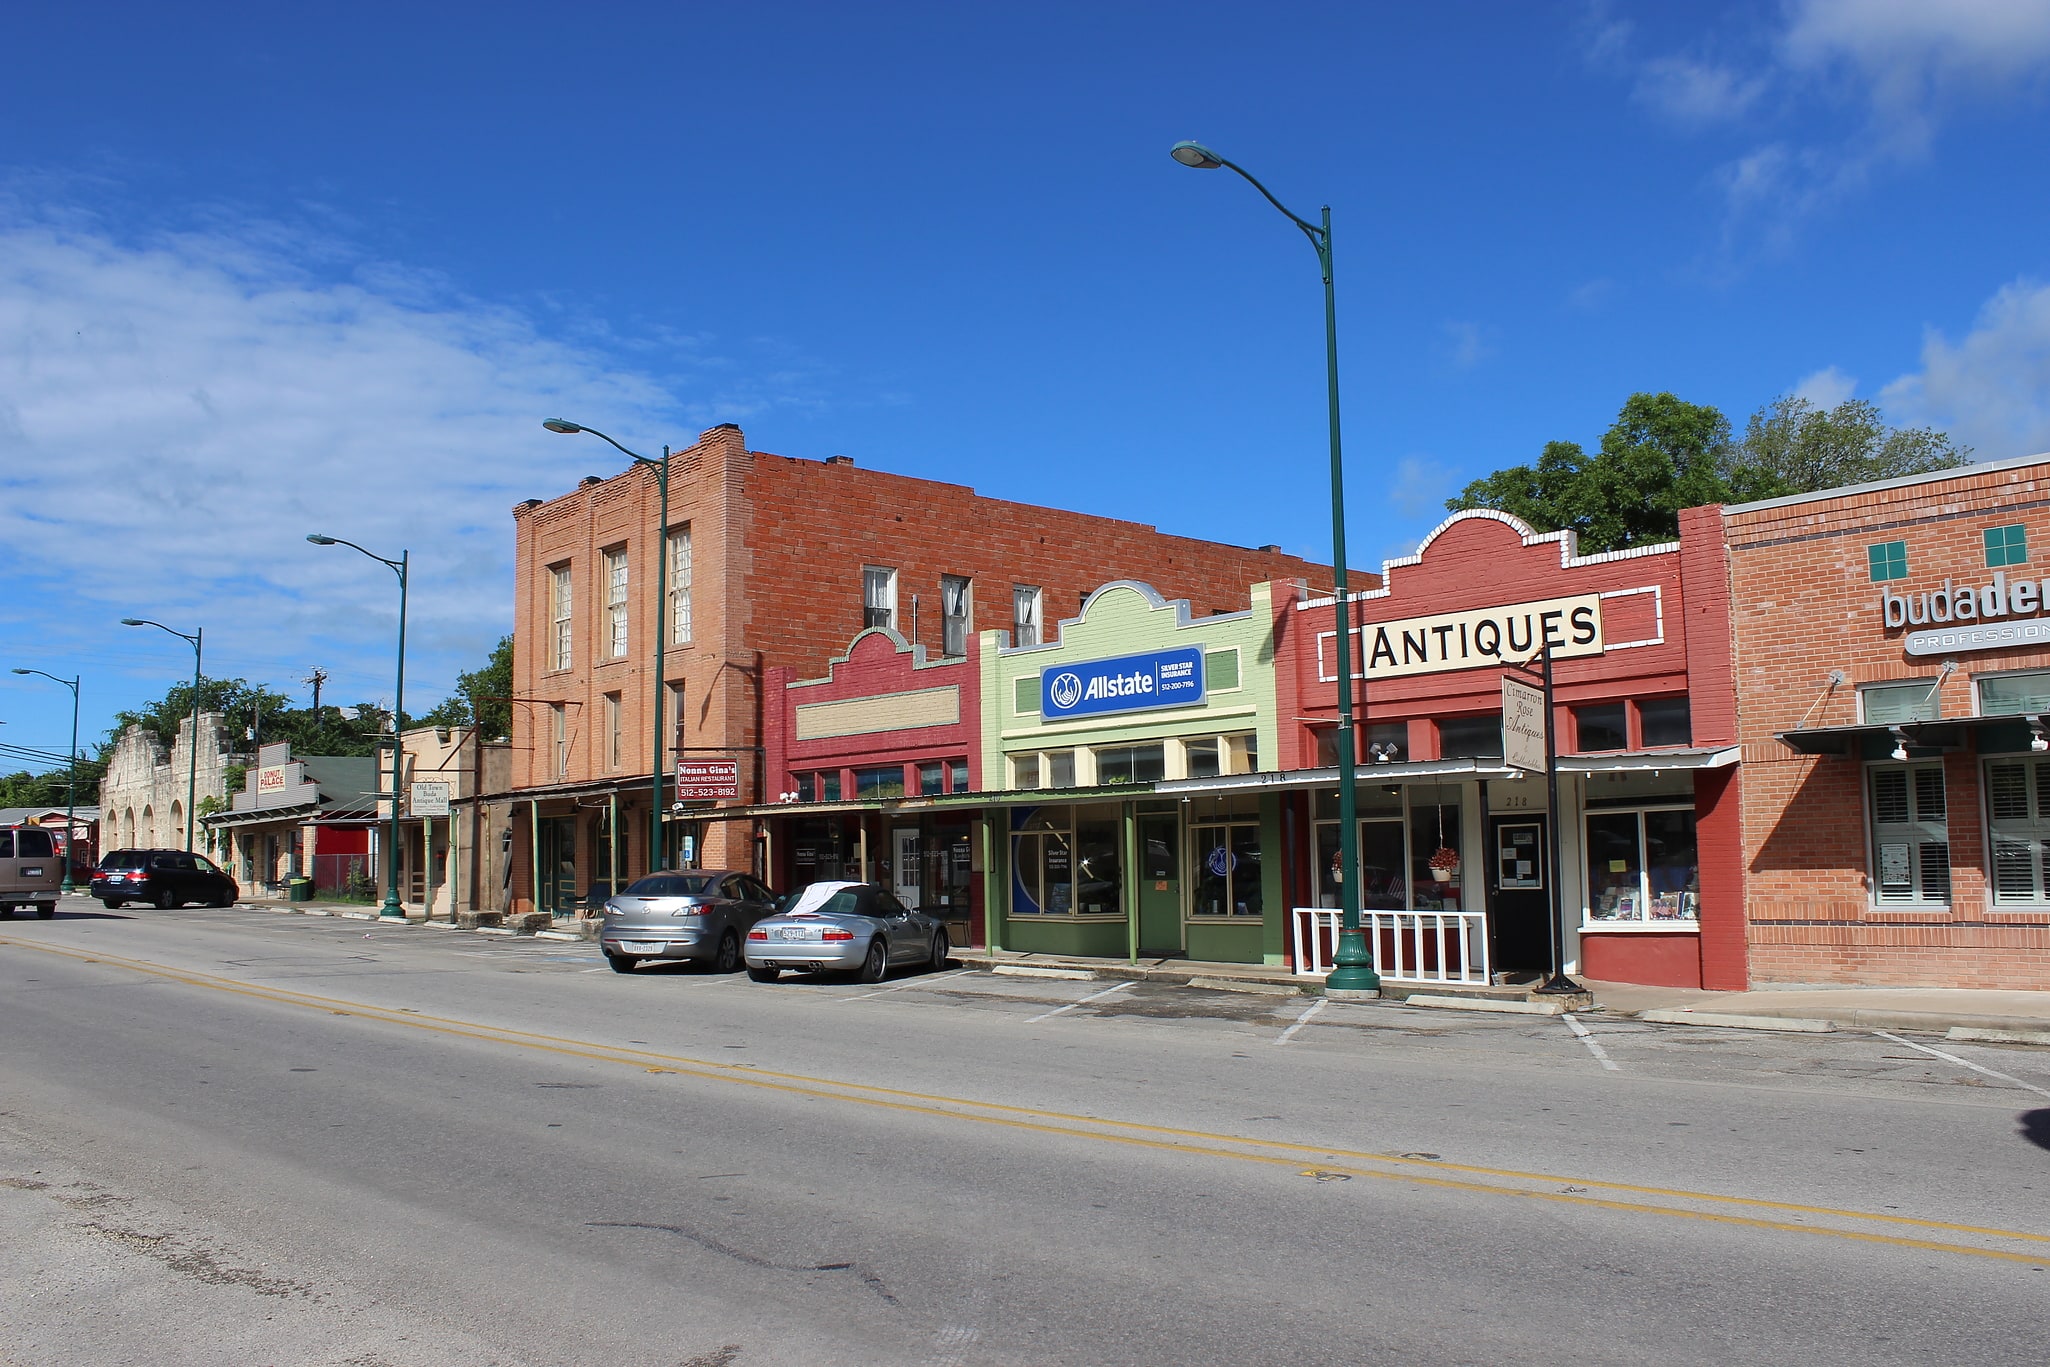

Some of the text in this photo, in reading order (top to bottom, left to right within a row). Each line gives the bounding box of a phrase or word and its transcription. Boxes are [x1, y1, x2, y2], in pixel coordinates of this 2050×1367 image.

[1881, 571, 2050, 628] budade
[1369, 606, 1596, 669] ANTIQUES
[1161, 661, 1193, 672] SILVER STAR
[1161, 669, 1192, 679] INSURANCE
[1084, 671, 1153, 701] Allstate
[1506, 683, 1543, 706] Cimarron
[1516, 700, 1533, 717] Rose
[1506, 714, 1544, 742] Antiques
[264, 770, 281, 778] DONUT
[680, 766, 736, 775] Nonna Gina's
[261, 776, 284, 786] PALACE
[1261, 773, 1286, 784] 218
[681, 788, 736, 797] 512-523-8192
[412, 797, 434, 805] Antique
[1506, 796, 1527, 807] 218
